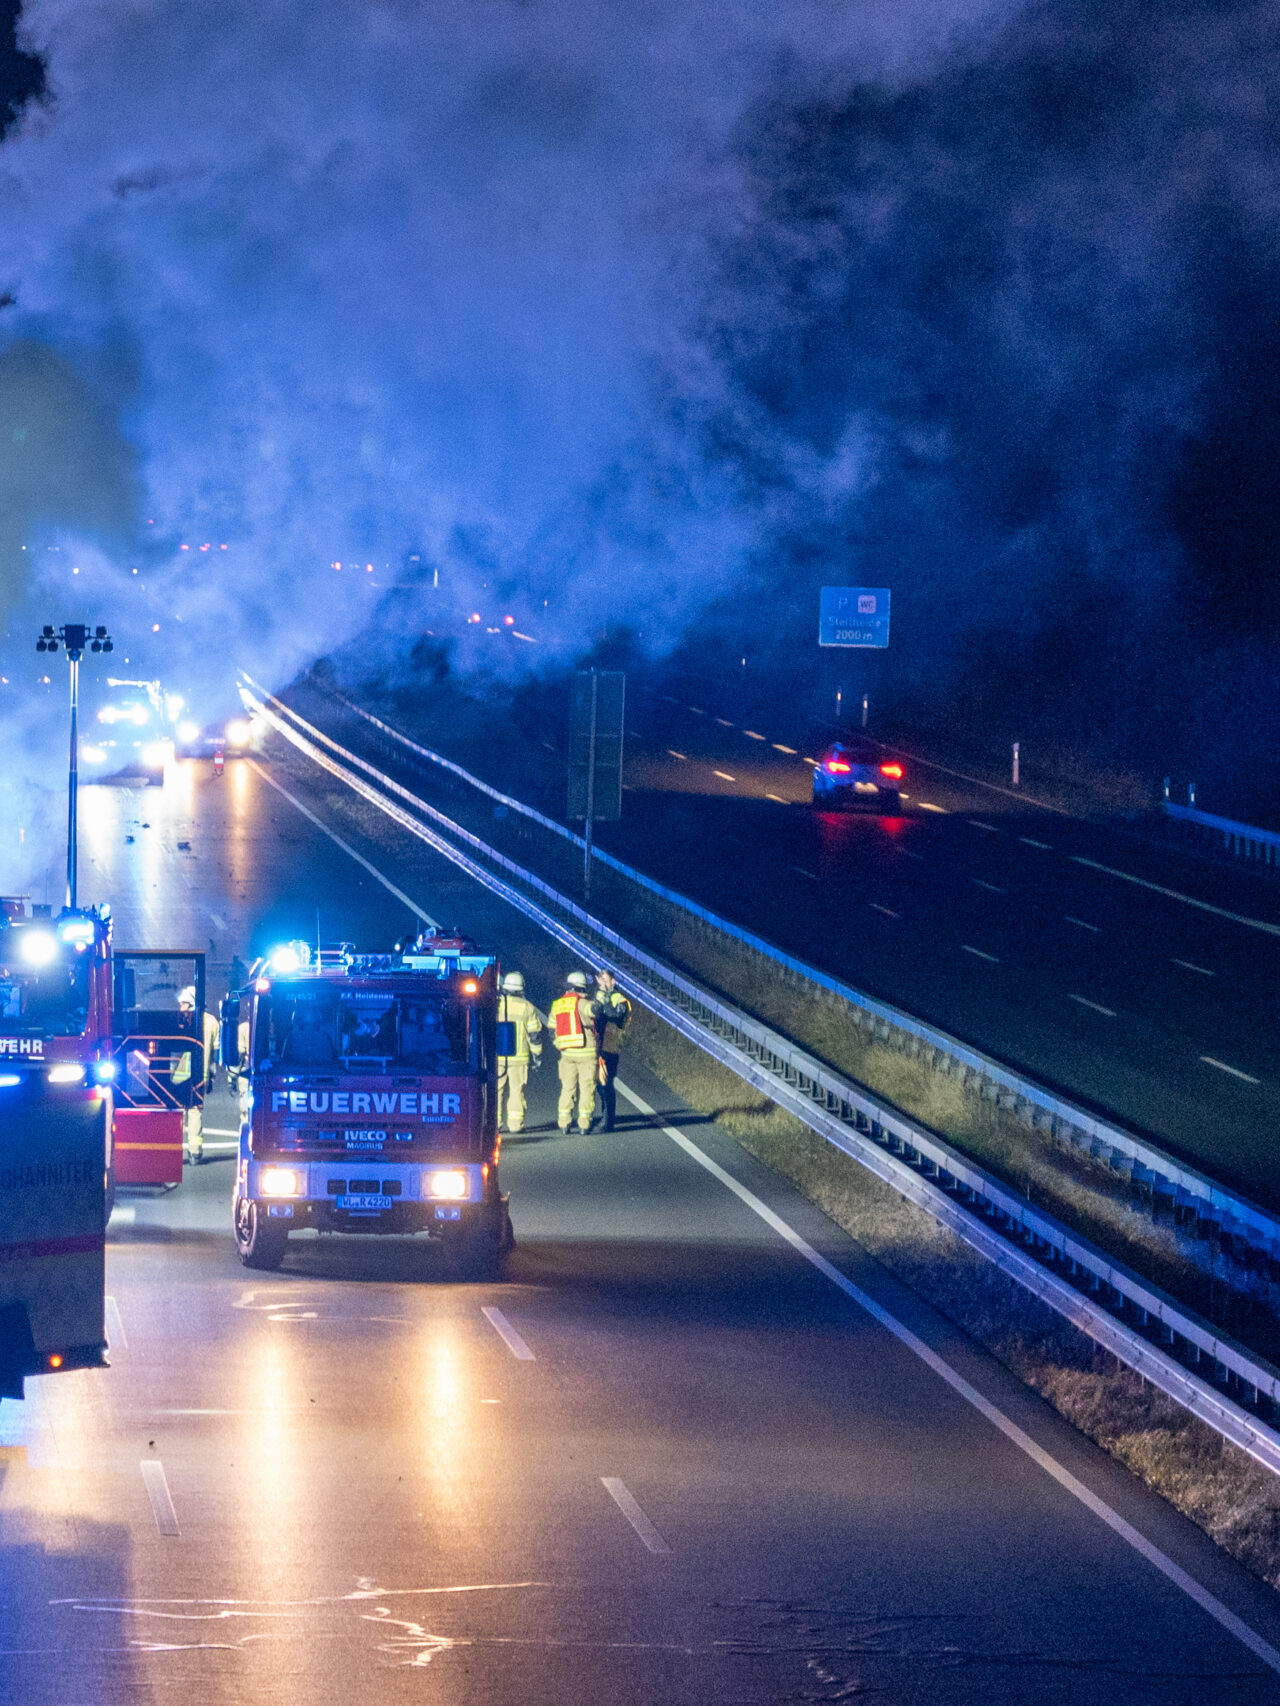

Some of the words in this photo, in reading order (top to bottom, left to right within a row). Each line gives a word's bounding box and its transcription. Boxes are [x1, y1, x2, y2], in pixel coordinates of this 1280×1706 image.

[860, 600, 874, 609] WC
[835, 629, 861, 640] 2000
[862, 632, 873, 640] m
[355, 992, 395, 1000] Heidenau
[271, 1090, 462, 1115] FEUERWEHR
[344, 1130, 388, 1142] IVECO
[346, 1142, 383, 1151] MAGIRUS
[368, 1198, 390, 1207] 4220
